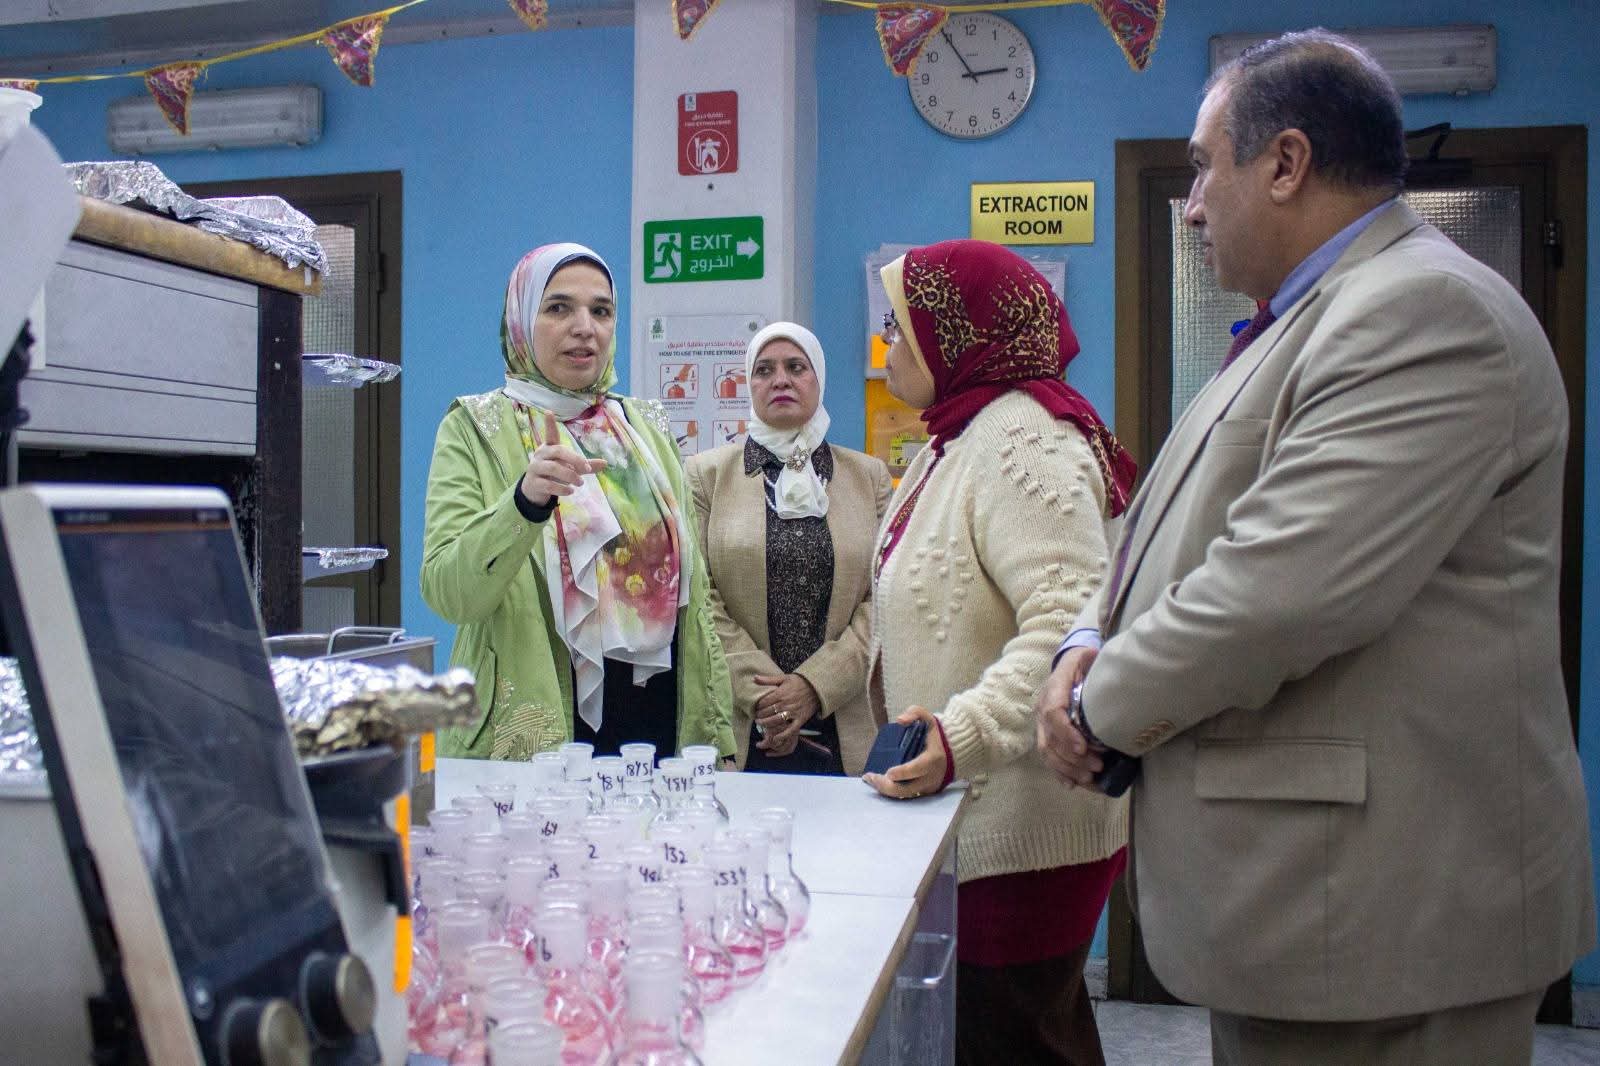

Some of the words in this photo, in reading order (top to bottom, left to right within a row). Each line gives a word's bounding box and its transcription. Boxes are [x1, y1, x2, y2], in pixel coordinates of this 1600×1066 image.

[965, 24, 977, 36] 12
[926, 52, 939, 63] 10
[1008, 47, 1017, 58] 2
[921, 73, 930, 85] 9
[1015, 68, 1024, 79] 3
[928, 95, 937, 107] 8
[1008, 91, 1017, 103] 4
[946, 111, 955, 122] 7
[992, 108, 1001, 120] 5
[968, 115, 977, 127] 6
[979, 195, 1088, 213] EXTRACTION
[1005, 220, 1063, 236] ROOM
[690, 234, 734, 250] EXIT
[689, 255, 734, 274] الخروج
[665, 366, 671, 374] 2
[588, 843, 600, 859] 2
[664, 842, 688, 864] 132
